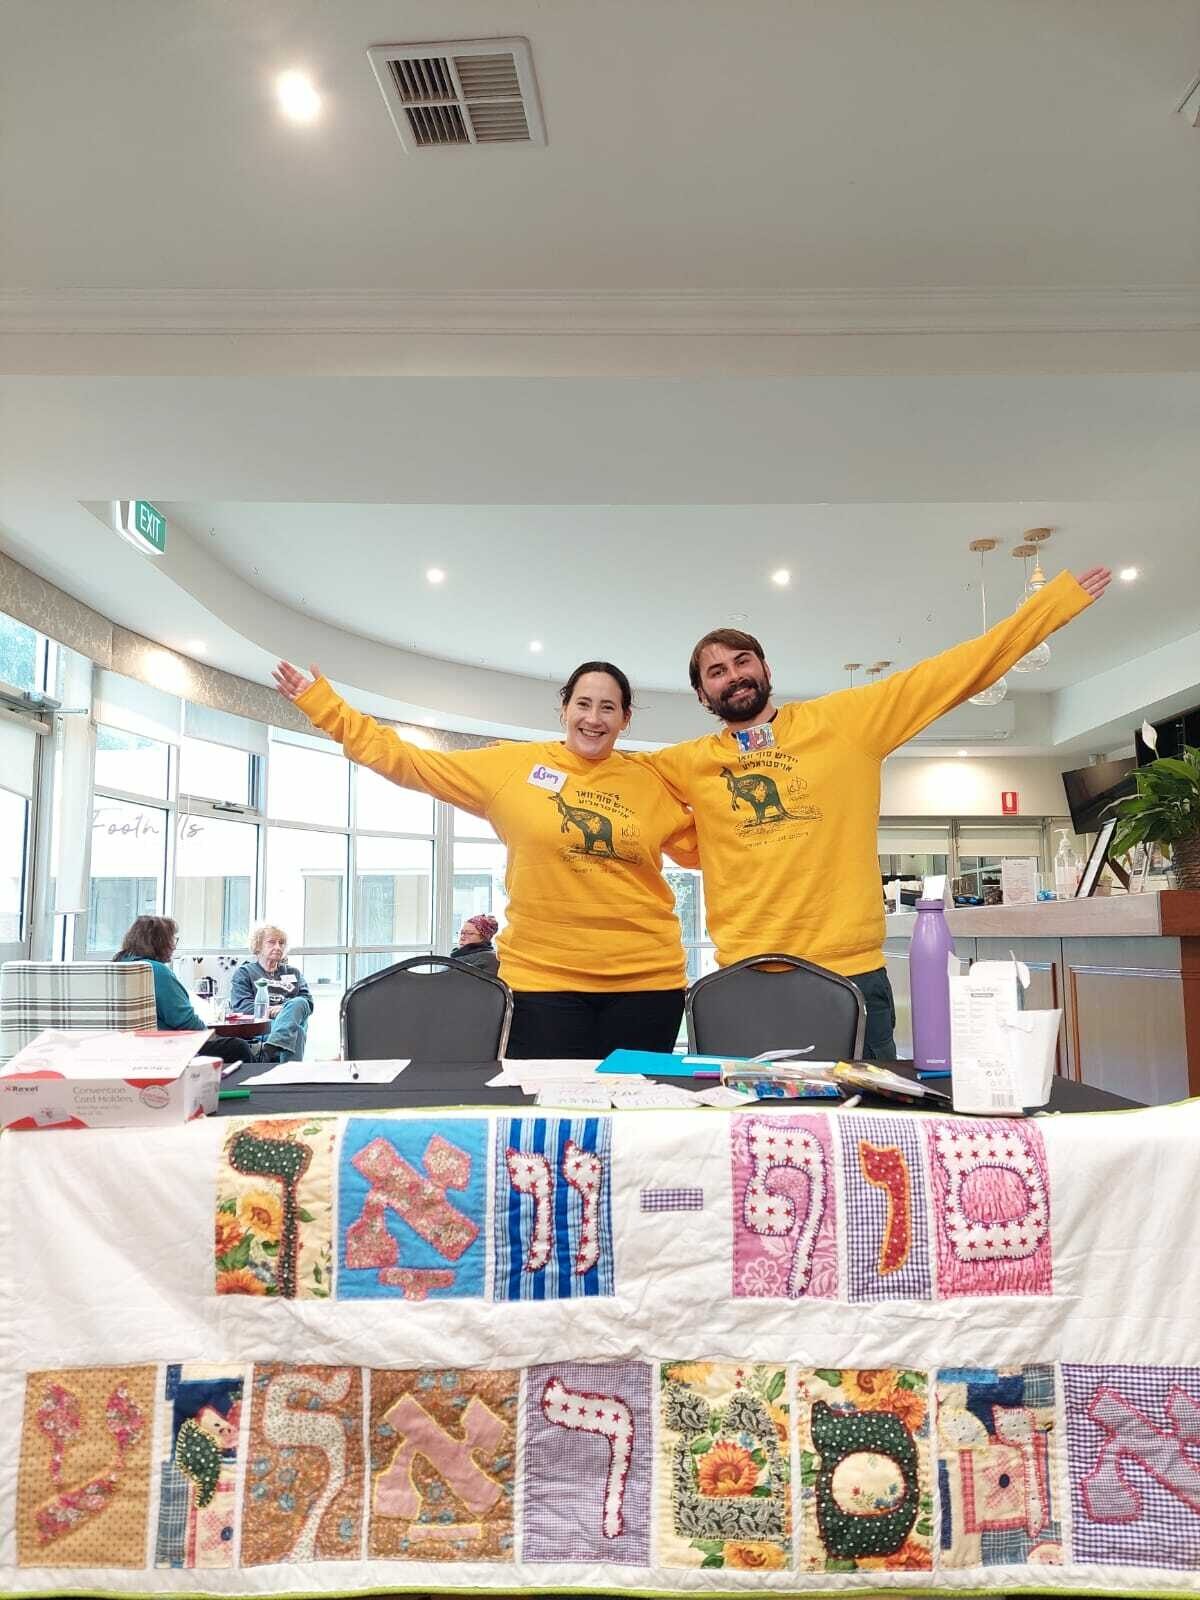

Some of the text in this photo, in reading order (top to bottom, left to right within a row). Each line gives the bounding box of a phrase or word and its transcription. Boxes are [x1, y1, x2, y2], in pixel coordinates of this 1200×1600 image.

[140, 503, 161, 542] EXIT
[72, 1086, 127, 1095] Convention
[74, 1095, 134, 1104] Card Holders
